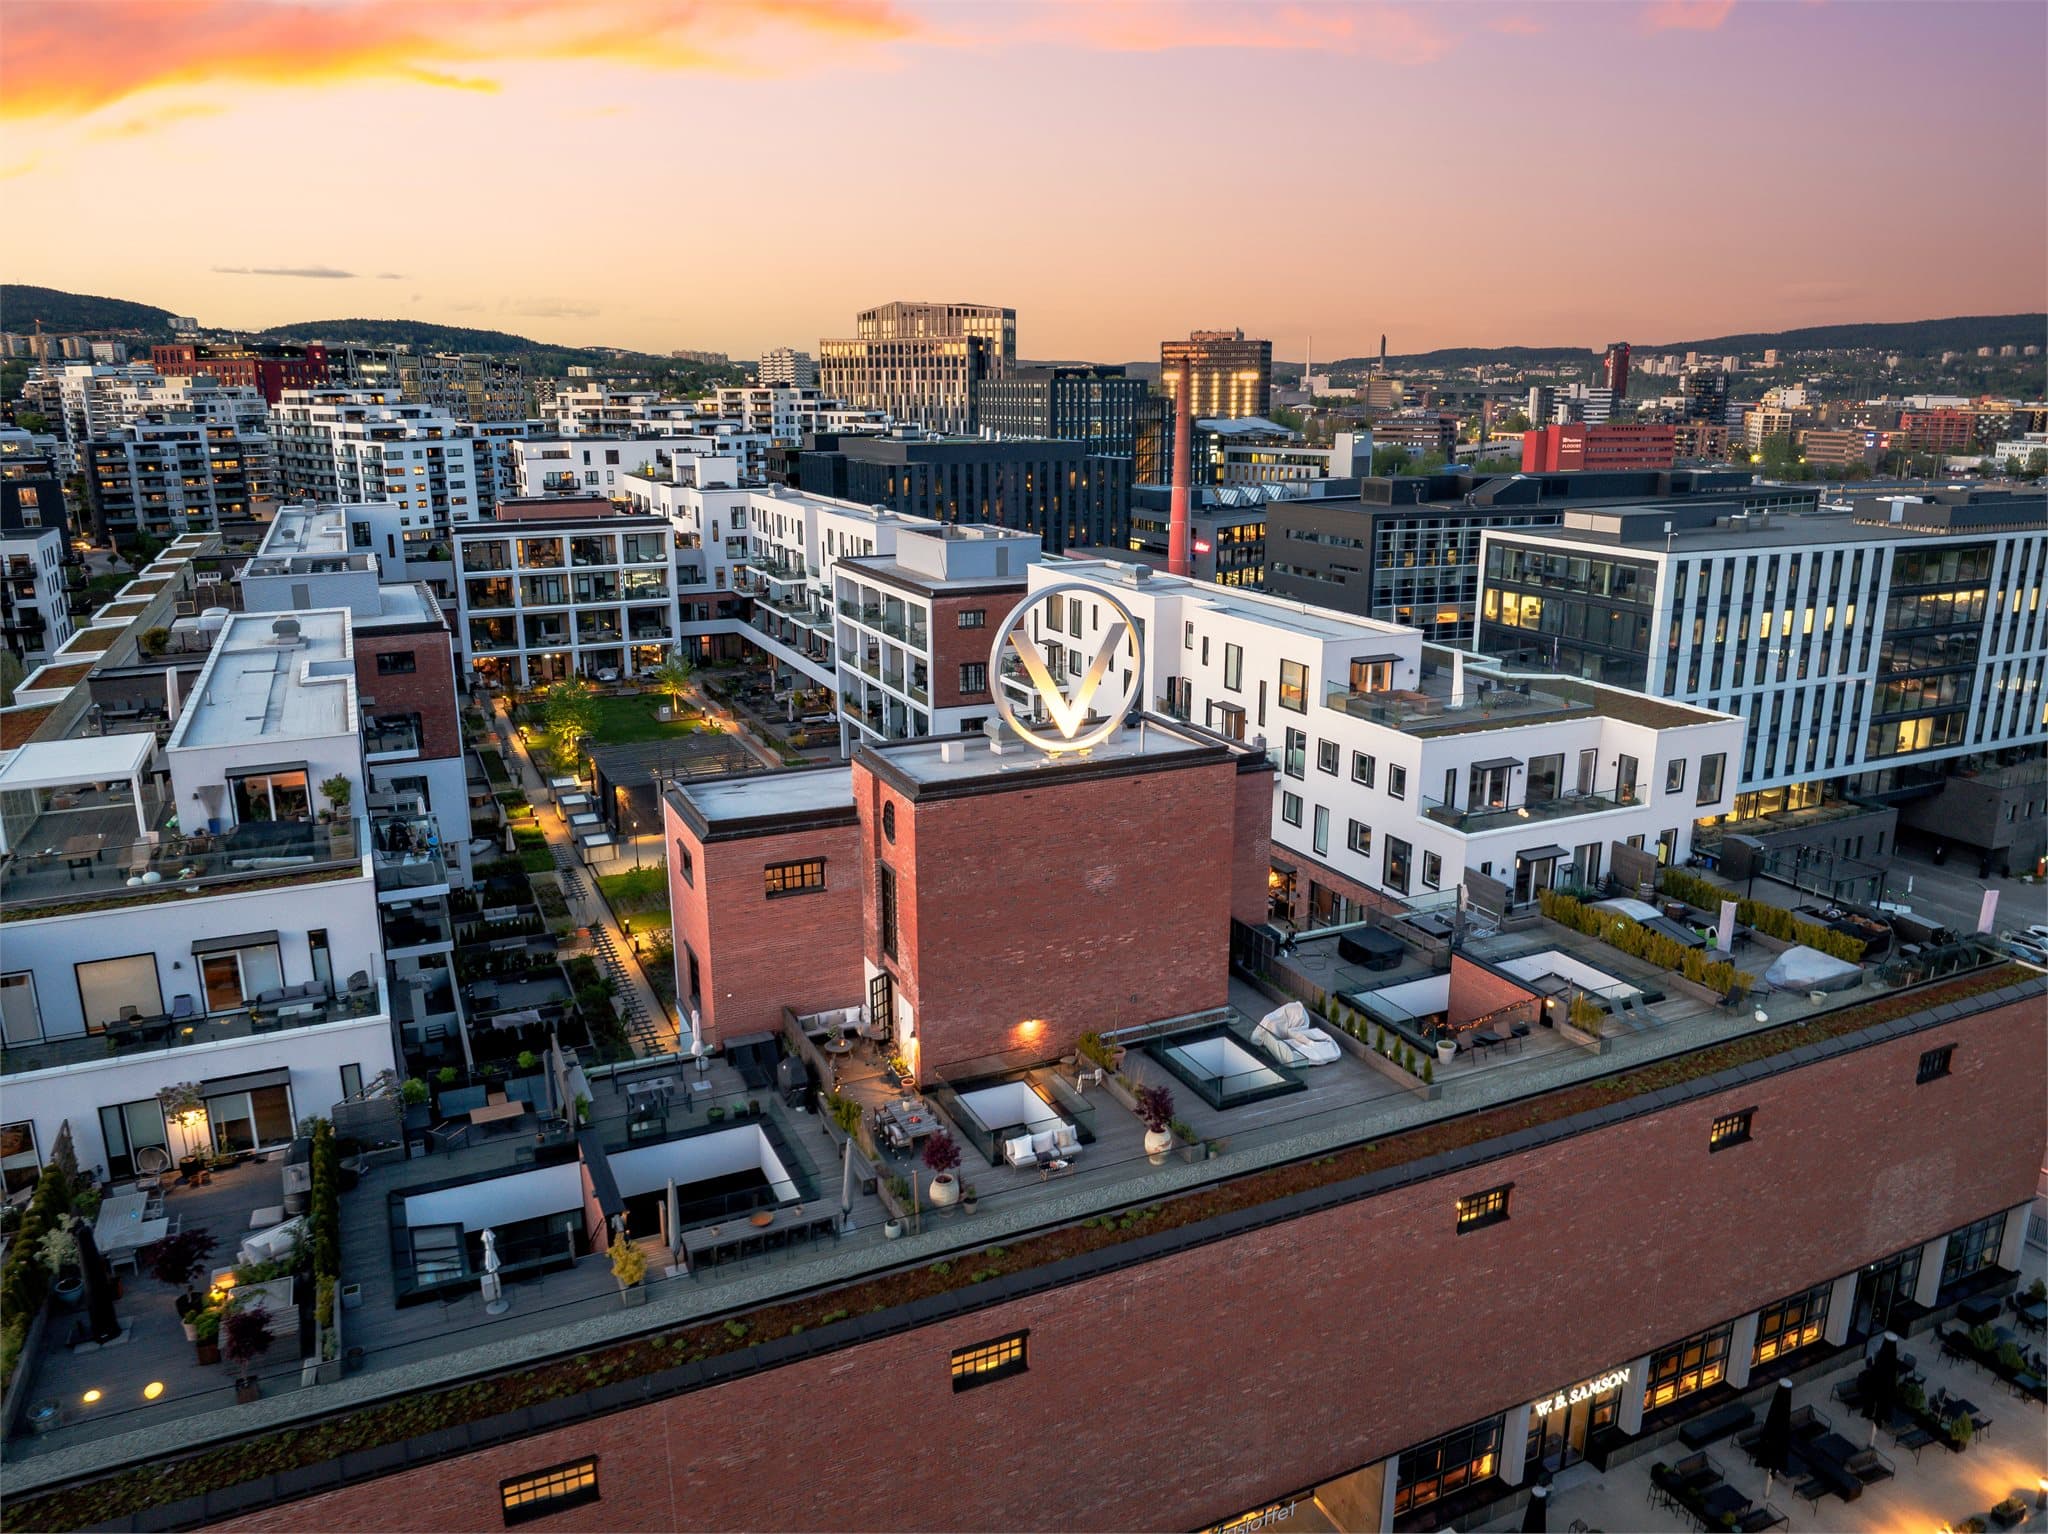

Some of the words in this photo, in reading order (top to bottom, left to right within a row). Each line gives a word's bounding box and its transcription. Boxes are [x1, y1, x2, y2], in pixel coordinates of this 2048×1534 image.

[1009, 622, 1128, 739] V
[1535, 1400, 1552, 1416] W.
[1554, 1394, 1568, 1411] B.
[1569, 1368, 1630, 1404] SAMSON
